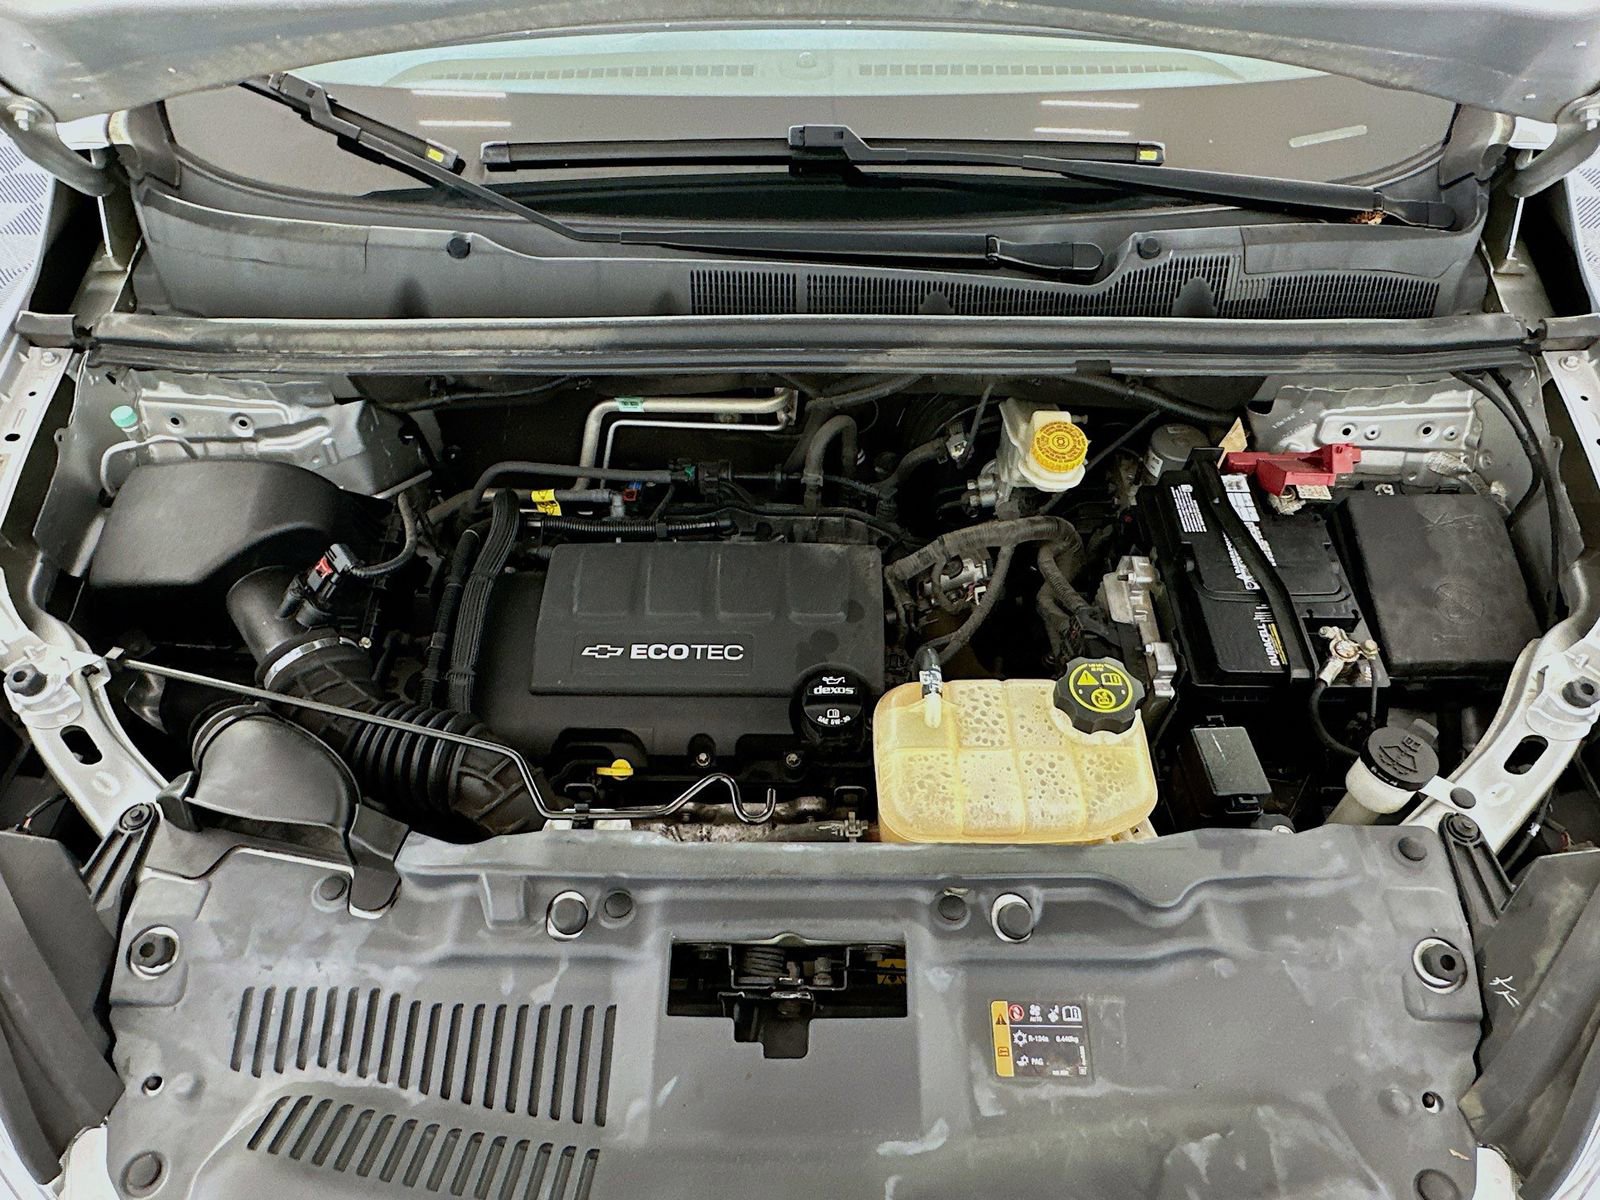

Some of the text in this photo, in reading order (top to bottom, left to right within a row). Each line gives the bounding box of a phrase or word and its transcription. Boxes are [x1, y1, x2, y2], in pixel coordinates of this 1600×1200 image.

[630, 644, 744, 660] ECOTEC
[1257, 623, 1280, 667] DURACELL
[813, 685, 855, 695] dexos
